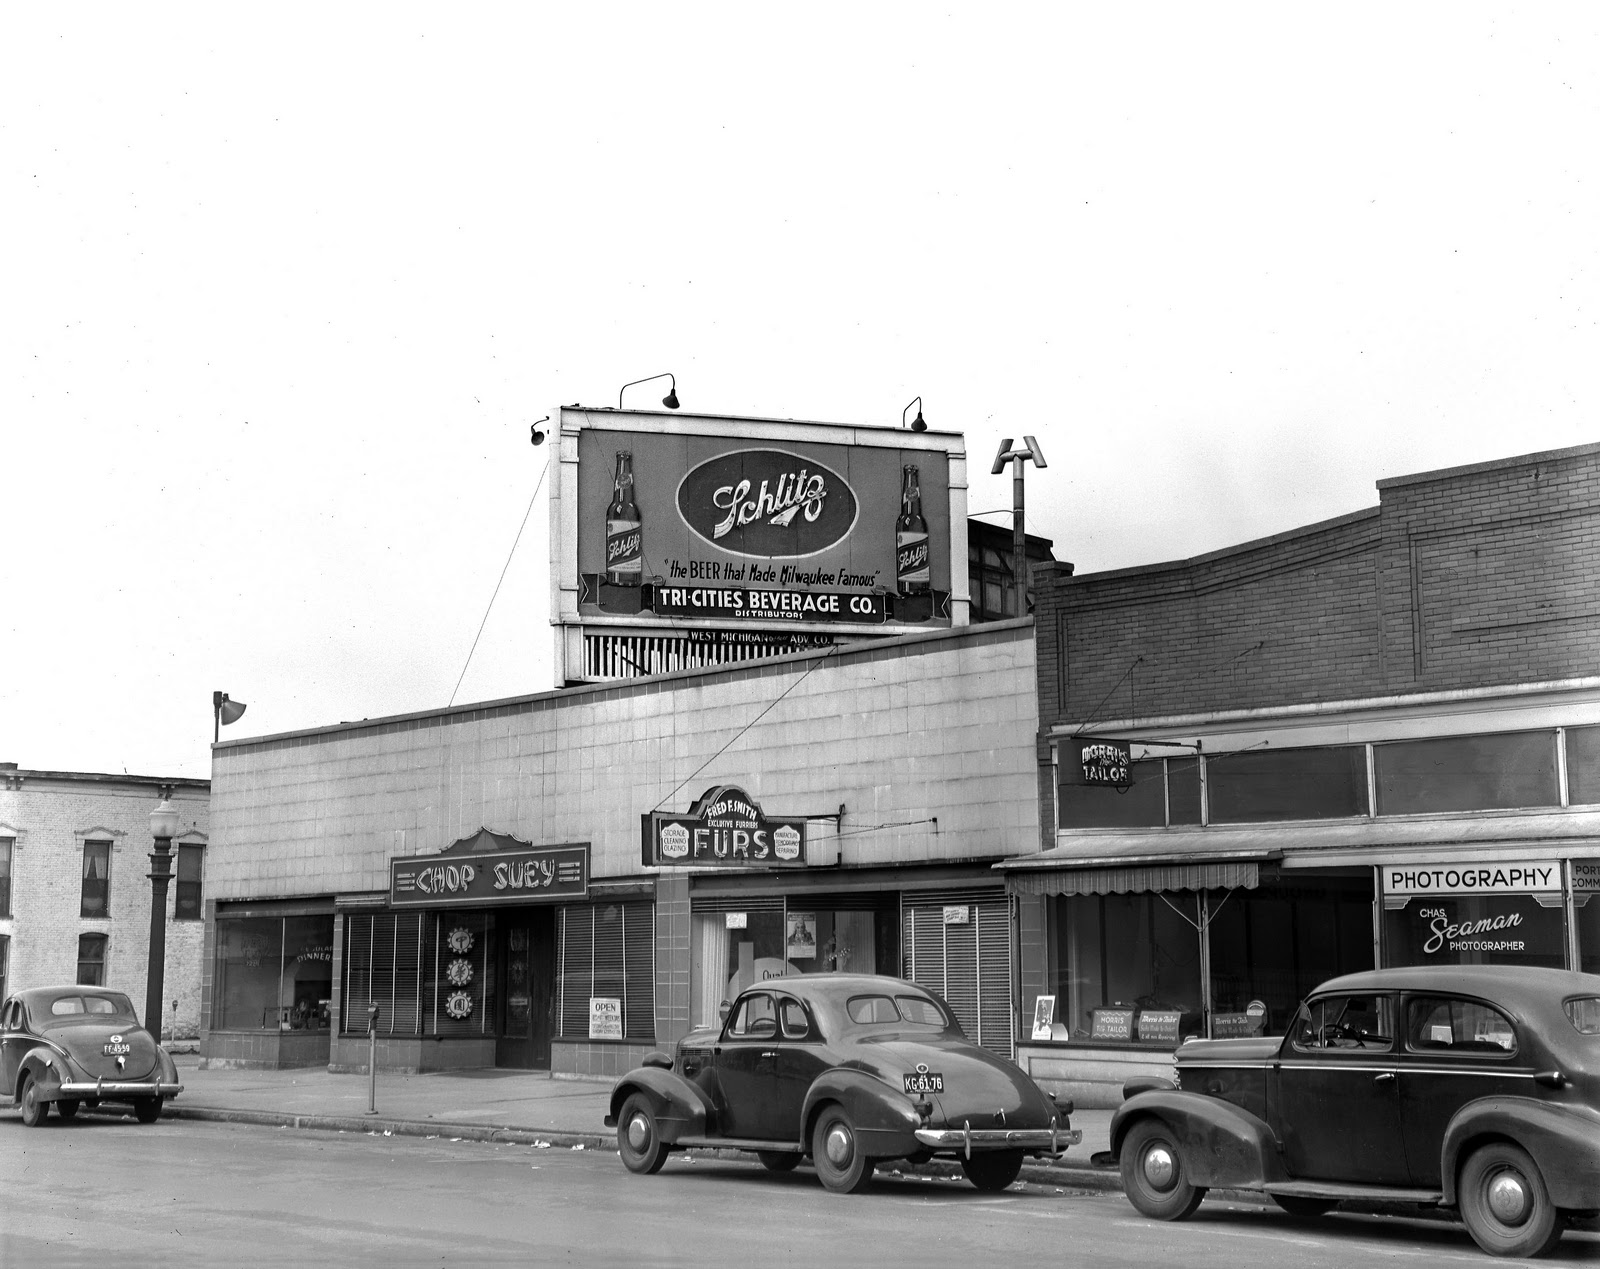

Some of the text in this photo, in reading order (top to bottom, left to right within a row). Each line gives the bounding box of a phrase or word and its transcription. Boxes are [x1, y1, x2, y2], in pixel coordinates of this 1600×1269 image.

[712, 469, 828, 539] Schlitz
[609, 533, 641, 562] Schlitz
[690, 561, 720, 579] BEER
[723, 563, 746, 581] that
[749, 564, 776, 582] Made
[780, 566, 835, 585] Milwaukee
[749, 591, 840, 613] BEVERAGE
[850, 597, 877, 614] CO.
[735, 610, 803, 620] DISTRIBUTORS
[691, 631, 716, 641] WEST
[721, 632, 769, 643] MICHIGAN
[814, 635, 831, 645] CO.
[1082, 744, 1128, 766] MORRIS
[1082, 766, 1127, 781] TAILOR
[707, 799, 757, 821] FRED F. SMITH
[707, 819, 758, 829] EXCLUSIVE FURRIERS
[663, 829, 686, 837] STORAGE
[663, 844, 687, 852] GLAZING
[693, 829, 769, 858] FURS
[776, 846, 798, 854] REPAIRING
[416, 859, 555, 893] CHOP SUEY
[1391, 868, 1553, 889] PHOTOGRAPHY
[1420, 908, 1447, 918] CHAS.
[1423, 912, 1523, 953] Seaman
[1450, 940, 1525, 951] PHOTOGRAPHER
[296, 952, 333, 963] DINNER
[595, 1002, 616, 1012] OPEN
[1100, 1016, 1124, 1024] MORRIS
[1107, 1025, 1128, 1033] TAILOR
